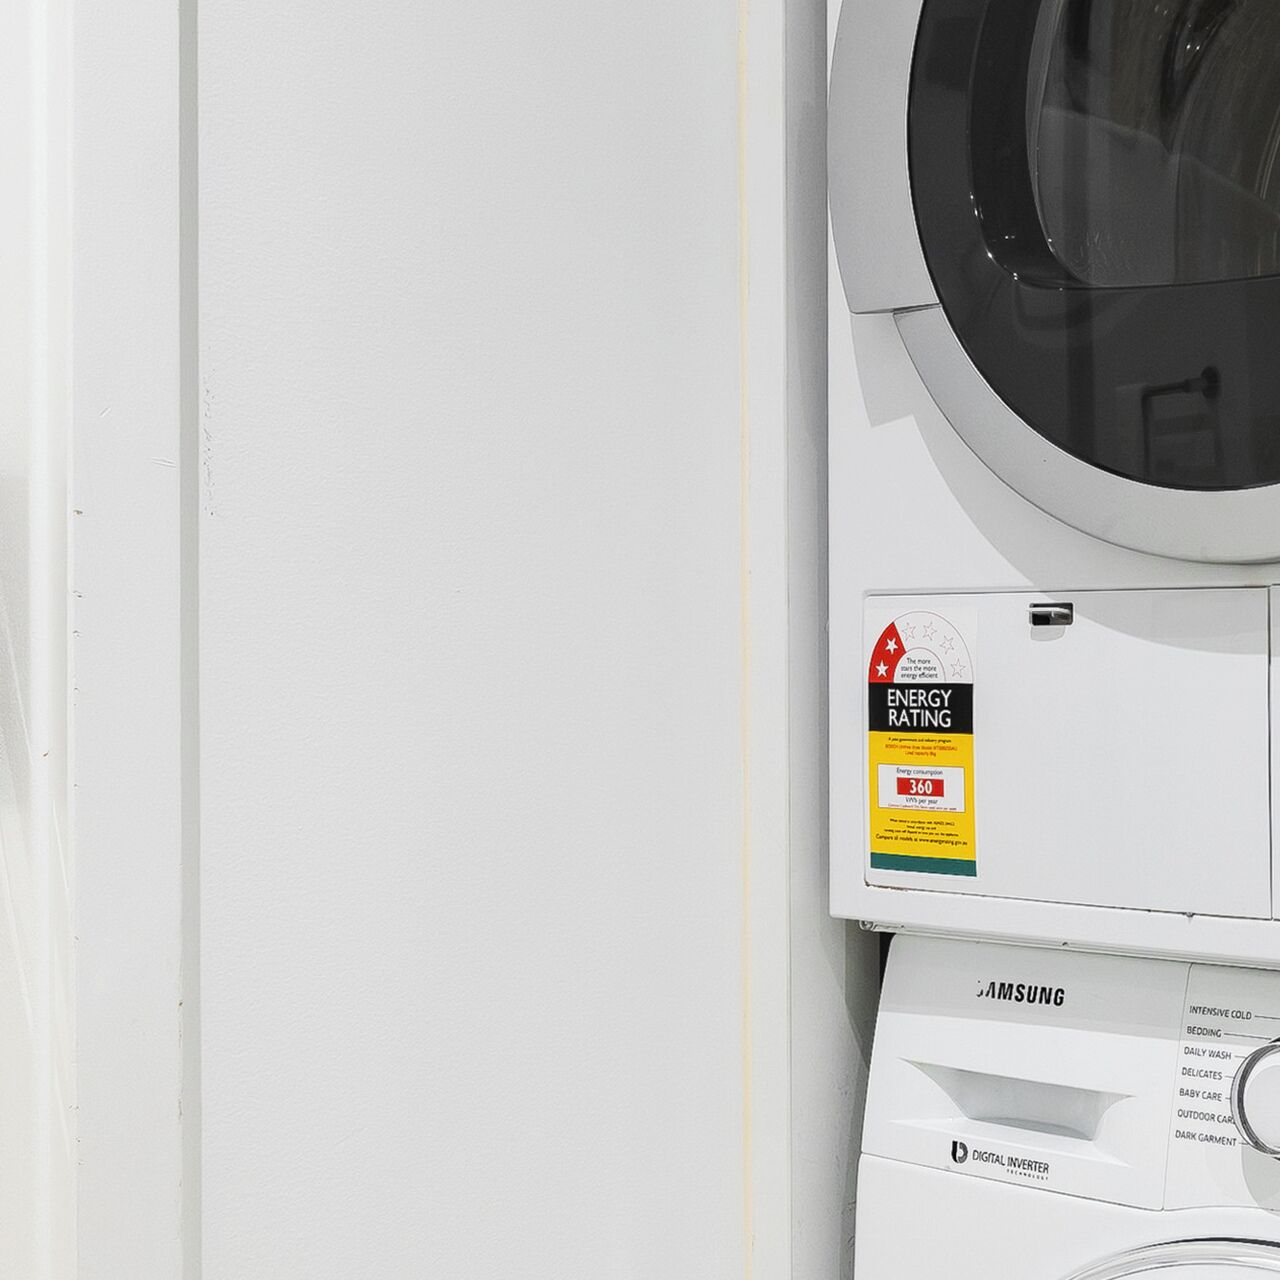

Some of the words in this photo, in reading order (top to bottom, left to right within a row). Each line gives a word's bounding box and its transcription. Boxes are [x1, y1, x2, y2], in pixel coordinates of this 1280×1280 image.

[888, 688, 952, 707] ENERGY
[889, 709, 951, 728] RATING
[896, 767, 912, 776] Energy
[909, 779, 933, 795] 360
[1189, 1005, 1230, 1018] INTENSIVE
[1231, 1011, 1253, 1020] COLD
[1187, 1026, 1222, 1038] BEDDING
[1184, 1046, 1207, 1057] DAILY
[1208, 1049, 1232, 1060] WASH
[1181, 1067, 1223, 1080] DELICATES
[1179, 1088, 1201, 1099] BABY
[1202, 1091, 1223, 1101] CARE
[1177, 1109, 1215, 1122] OUTDOOR
[1175, 1130, 1197, 1140] DARK
[1198, 1133, 1237, 1147] GARMENT
[972, 1149, 1006, 1166] DIGITAL
[1006, 1156, 1050, 1174] INVERTER
